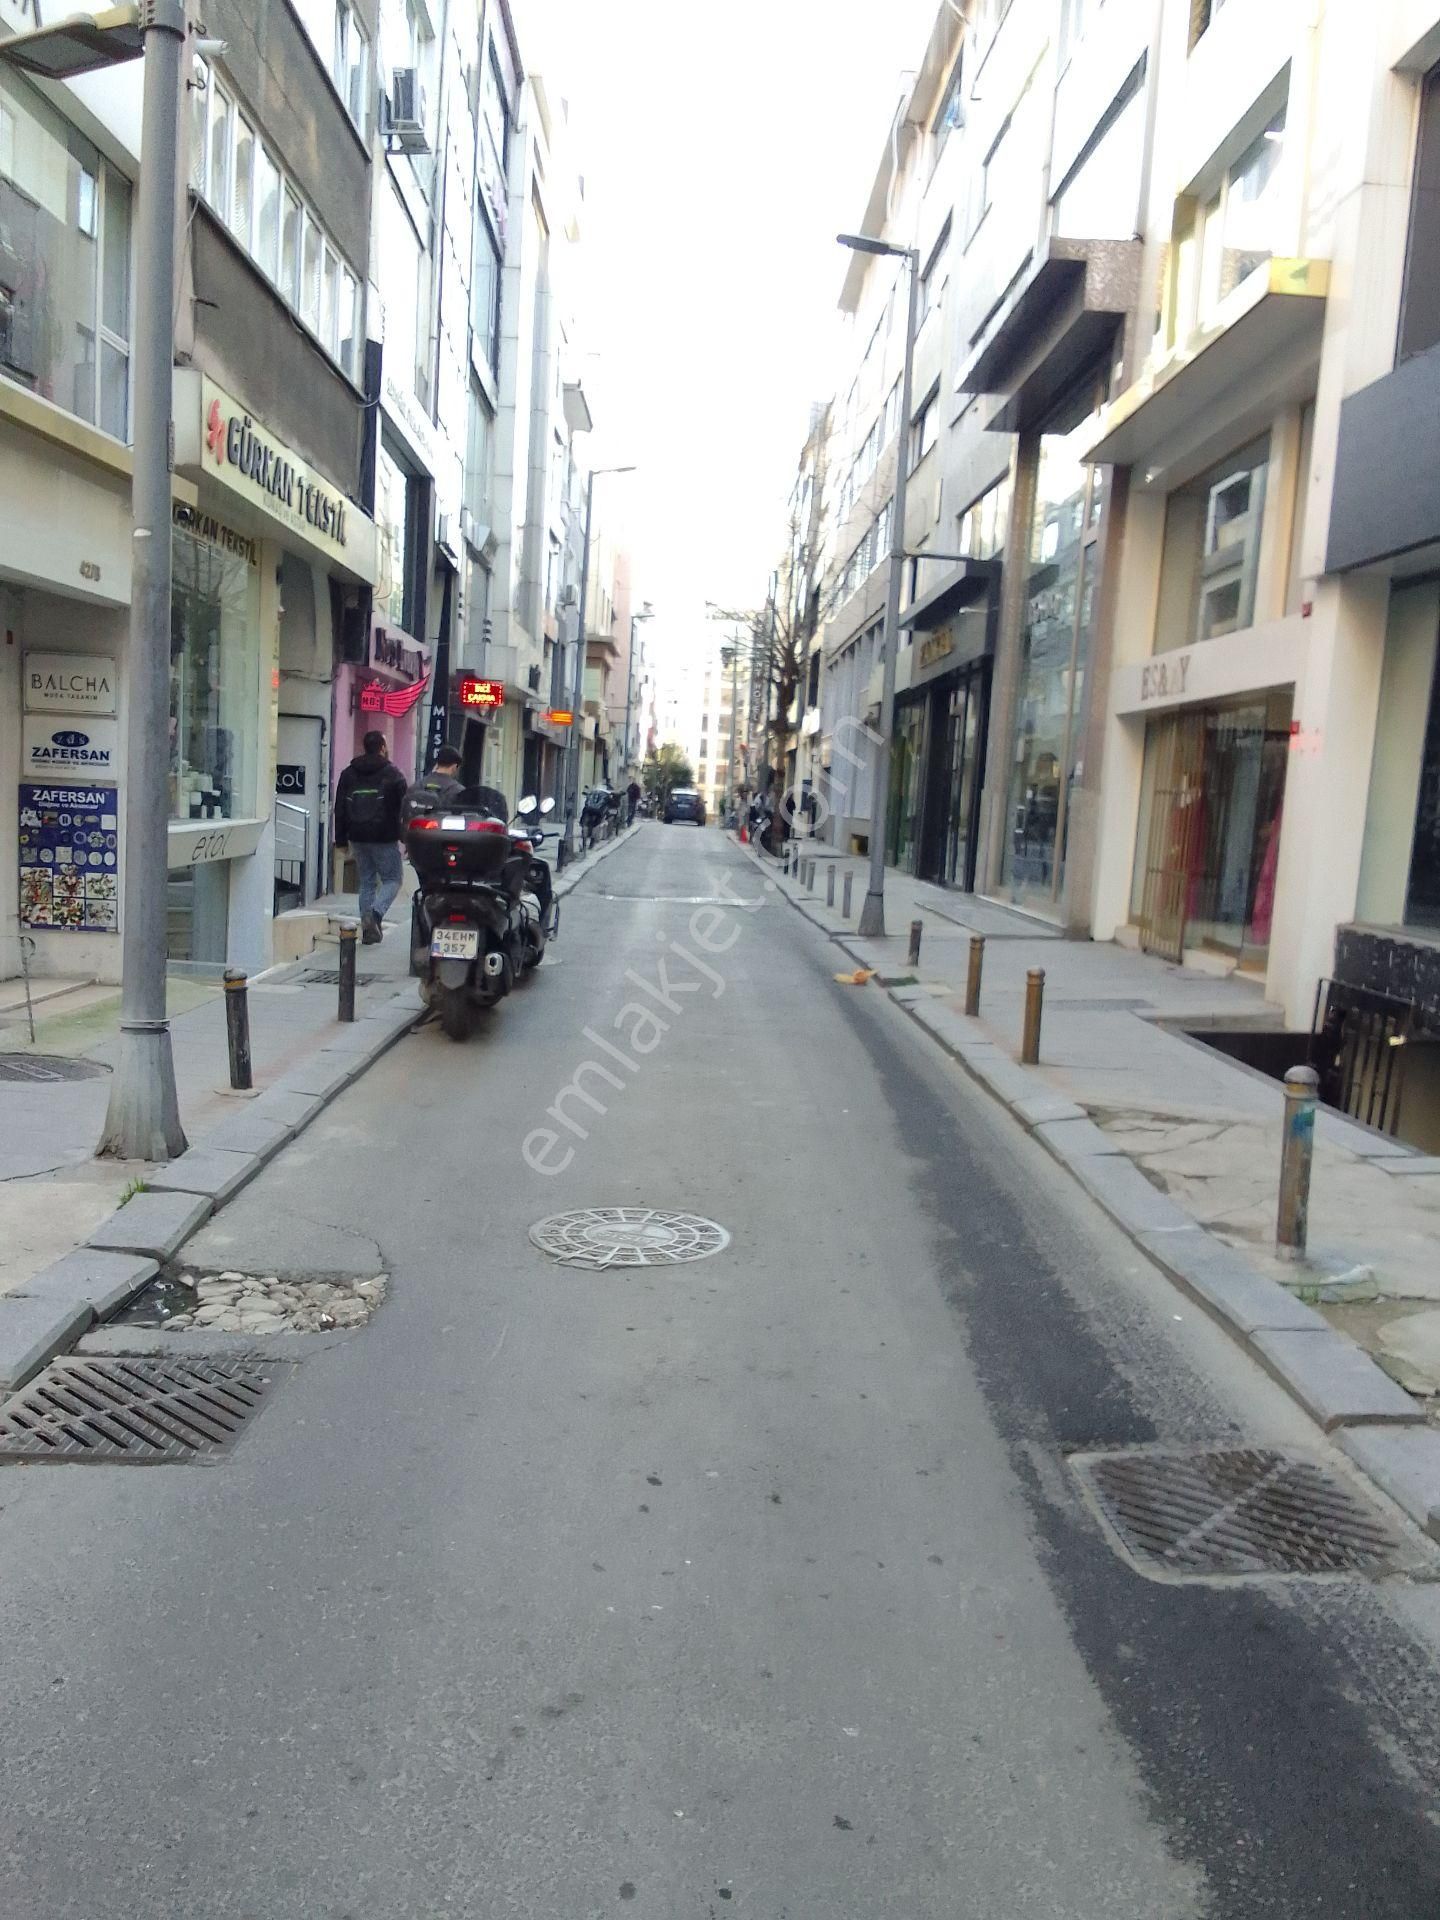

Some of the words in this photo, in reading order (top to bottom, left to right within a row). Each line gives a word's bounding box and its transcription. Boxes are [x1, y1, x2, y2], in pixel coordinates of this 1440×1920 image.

[226, 415, 296, 508] GÜRKAN
[298, 475, 347, 547] TEKSTİL
[221, 525, 257, 566] TEKSTİL
[31, 673, 110, 693] BALCHA
[32, 747, 110, 761] ZAFERSAN
[33, 790, 105, 804] ZAFERSAN
[192, 829, 231, 862] etol
[443, 943, 466, 953] 357
